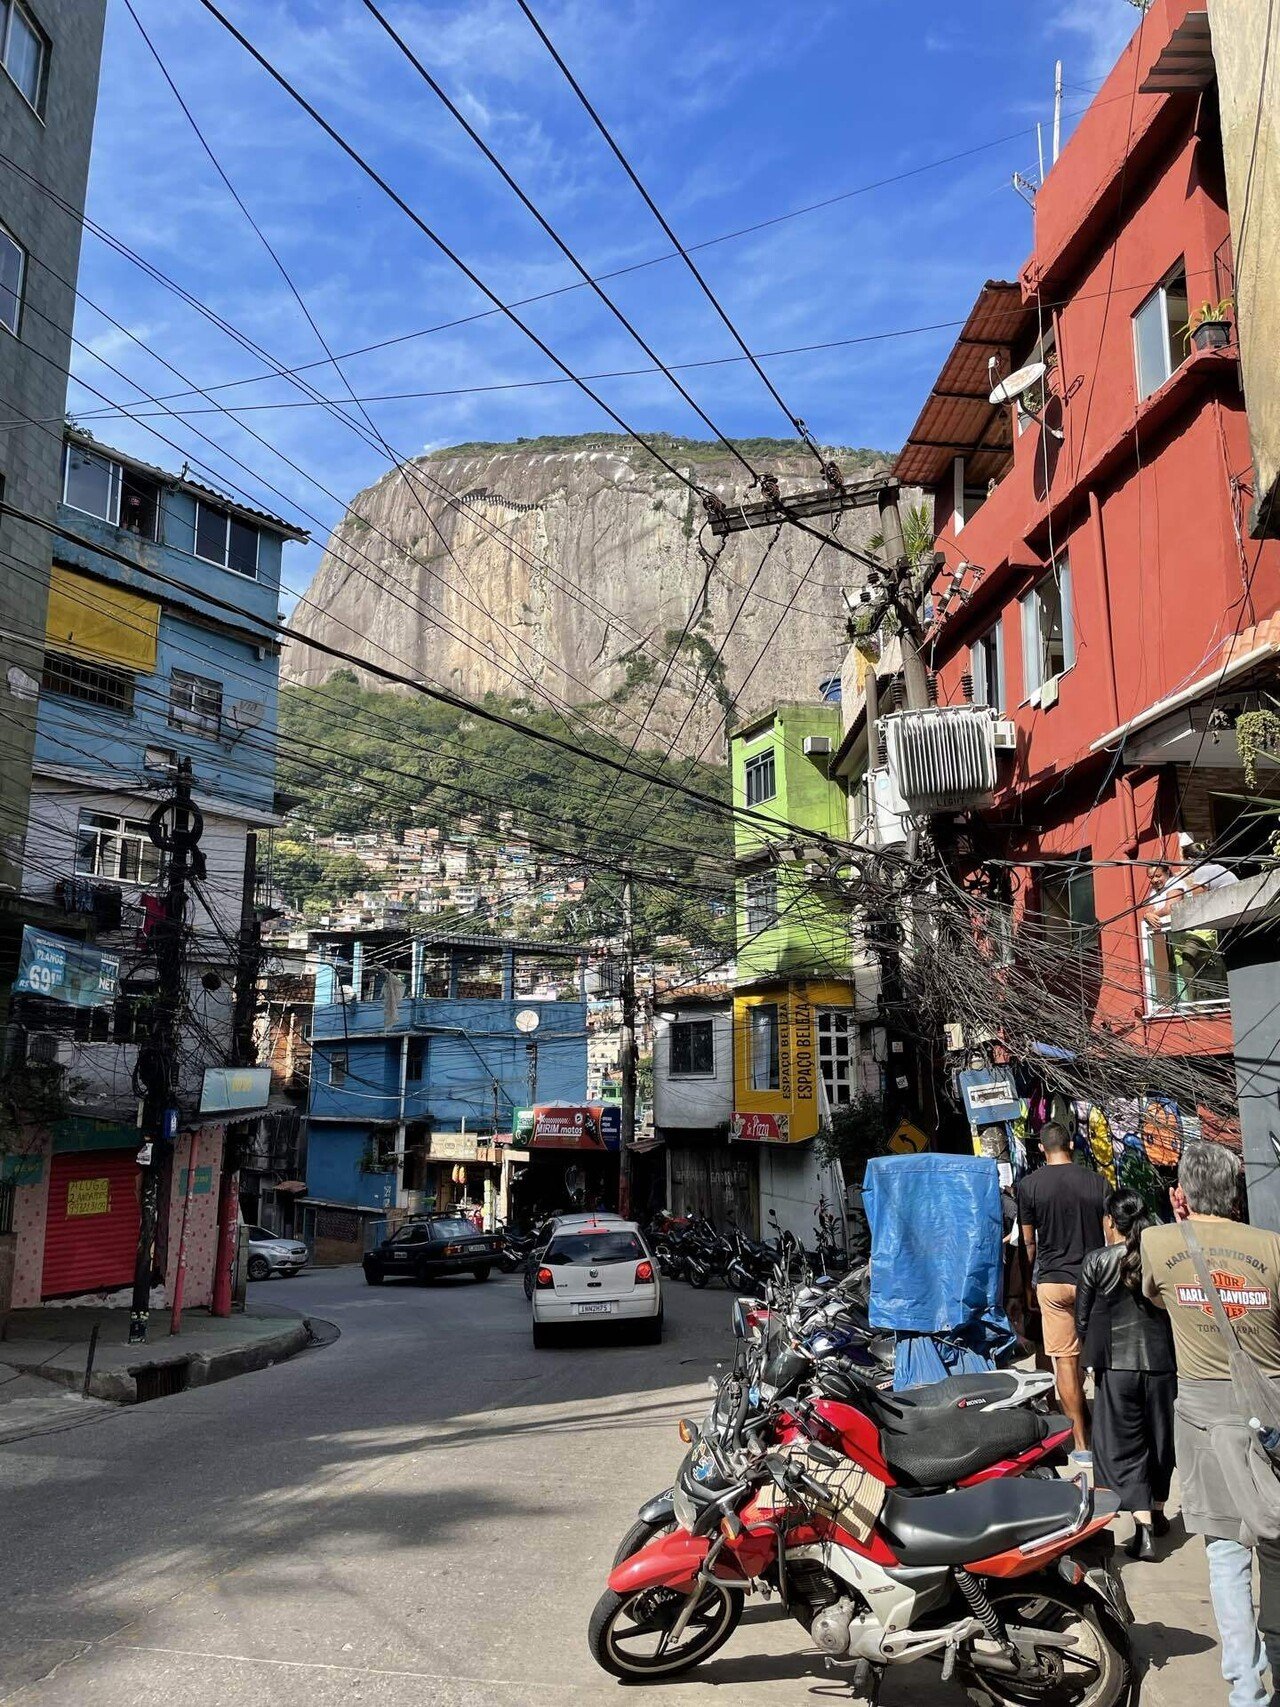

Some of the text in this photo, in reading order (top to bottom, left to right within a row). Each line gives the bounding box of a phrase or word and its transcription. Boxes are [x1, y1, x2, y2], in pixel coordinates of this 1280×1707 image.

[98, 976, 116, 992] NET
[795, 1002, 815, 1099] ESPAÇO BELEZA
[781, 1052, 791, 1099] ESPAÇO
[536, 1123, 583, 1135] MIRIM motos
[1209, 1247, 1268, 1274] DAVIDSON
